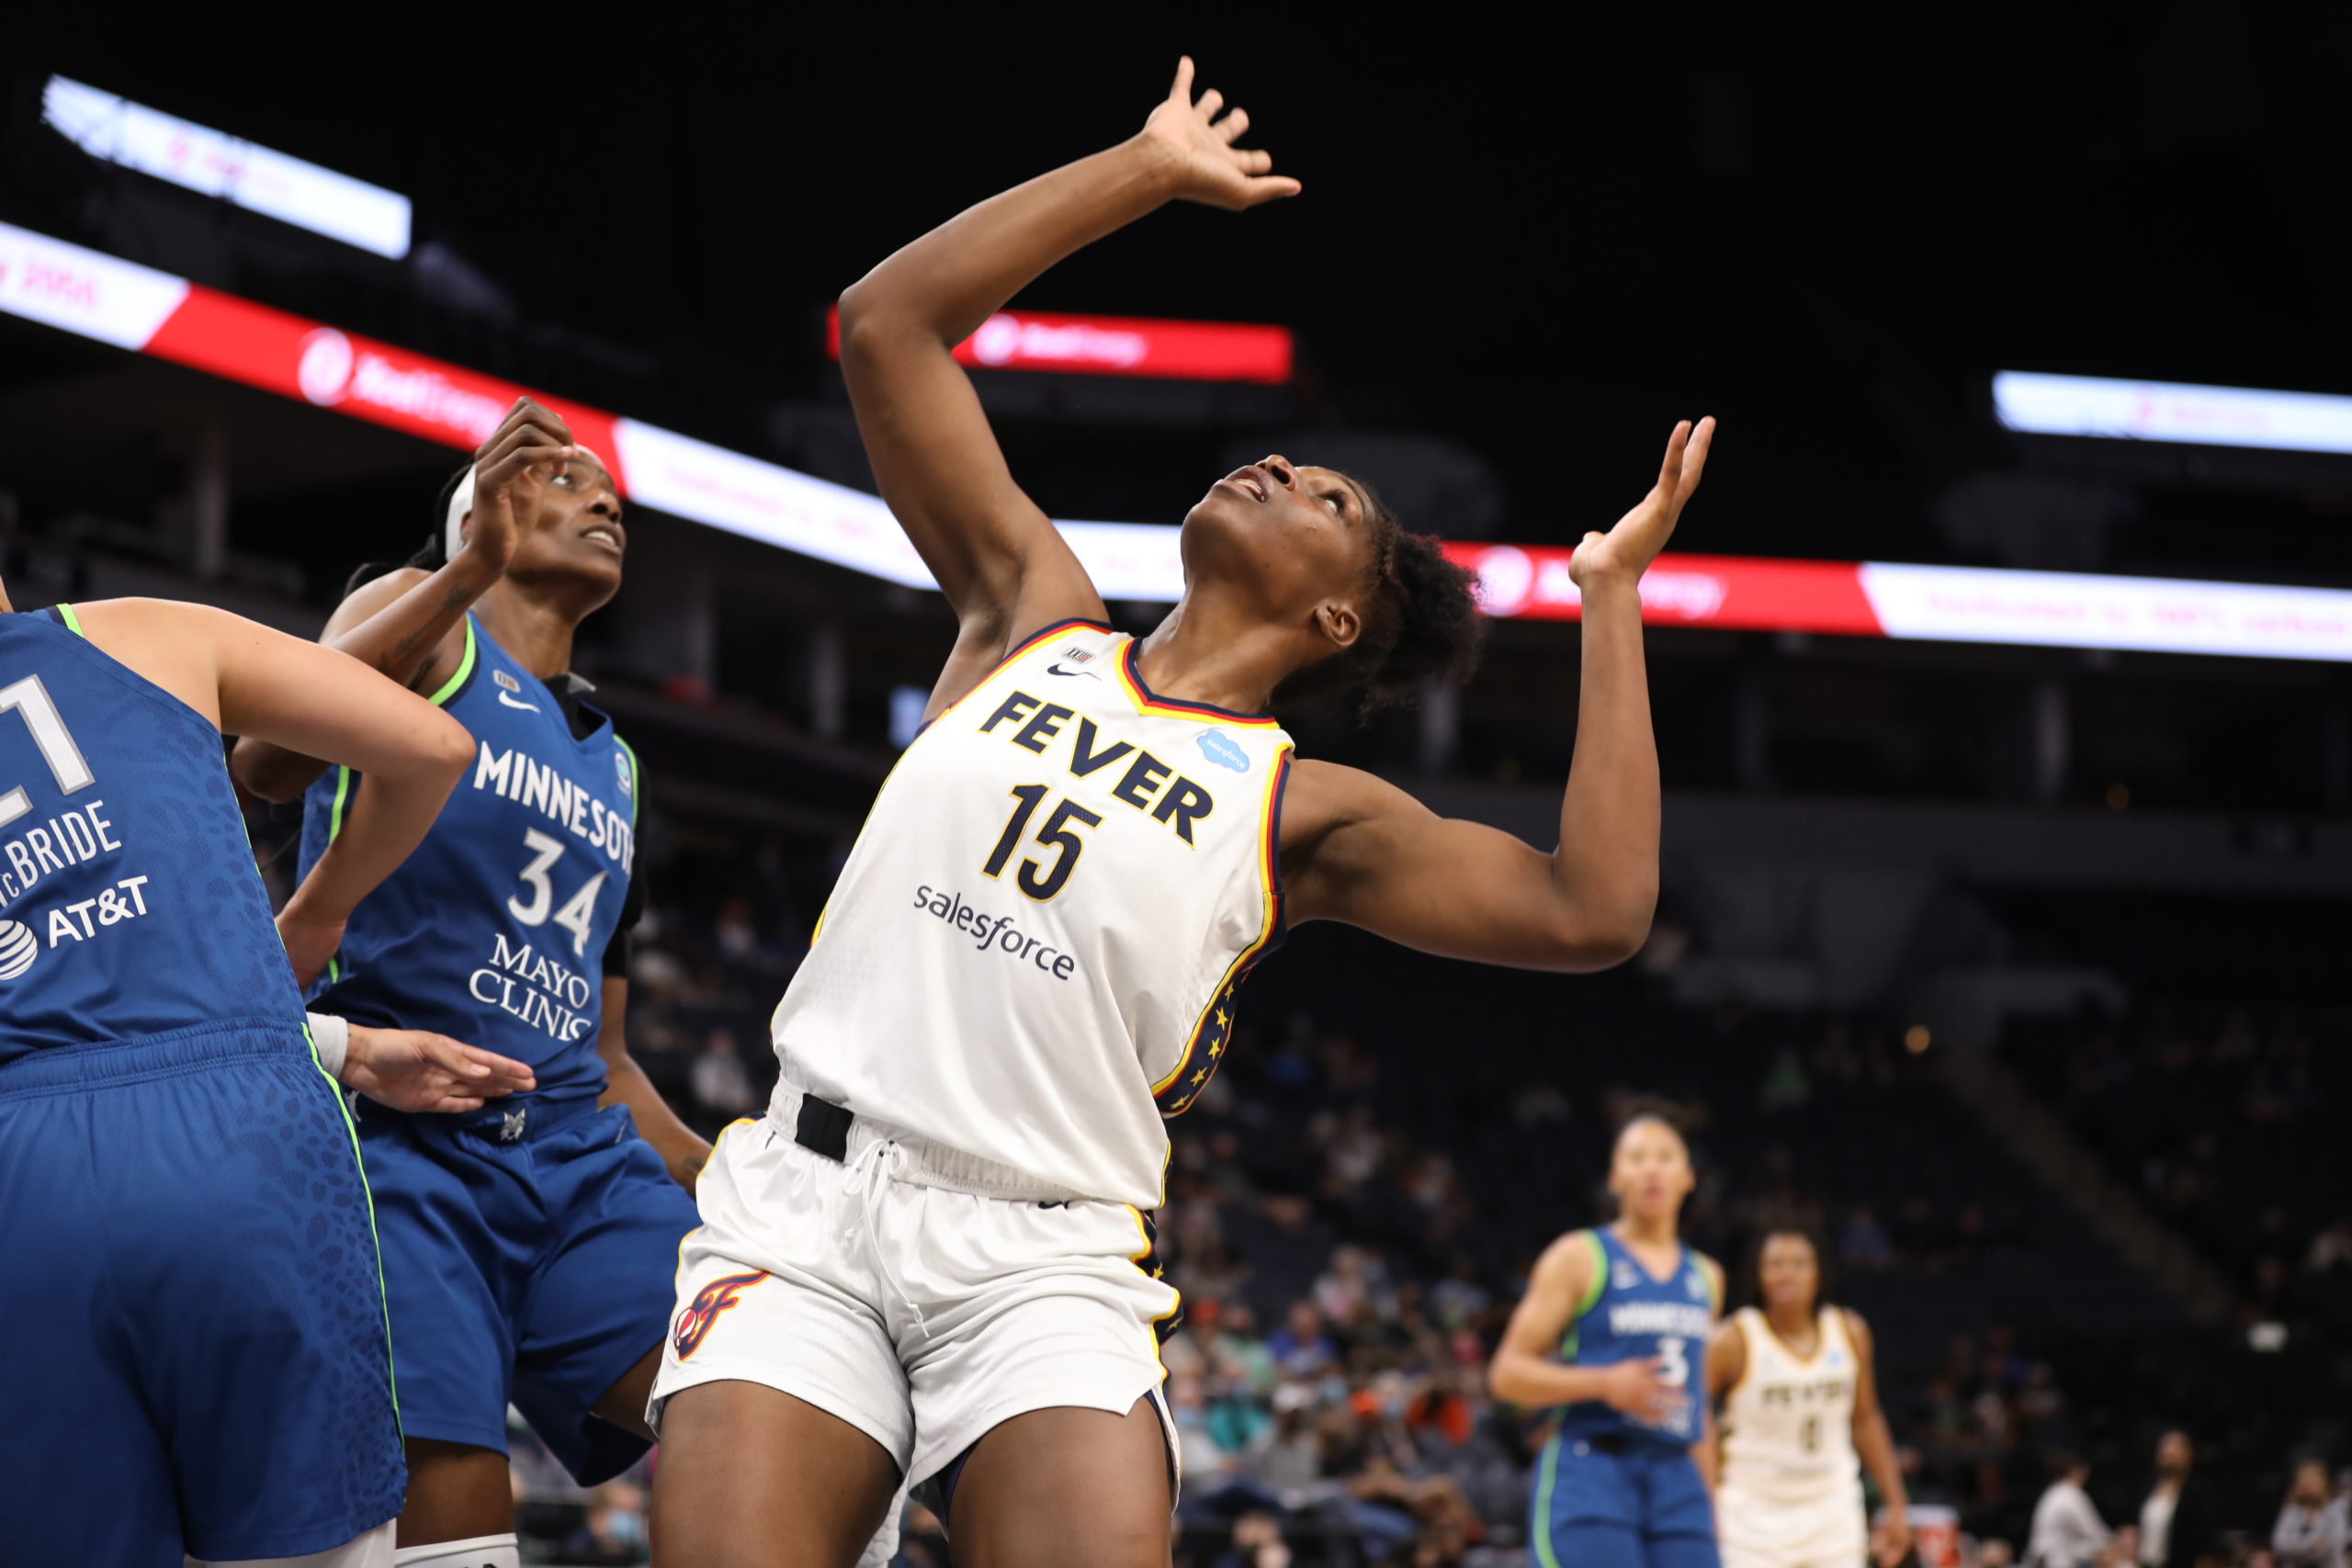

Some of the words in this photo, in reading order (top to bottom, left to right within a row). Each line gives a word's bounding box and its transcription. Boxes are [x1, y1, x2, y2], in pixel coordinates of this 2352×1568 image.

[976, 690, 1215, 852] FEVER
[1206, 739, 1246, 769] salesforce
[979, 784, 1106, 903] 15
[49, 874, 148, 949] AT&T
[507, 827, 607, 957] 34
[913, 885, 1075, 981] salesforce
[489, 933, 590, 1009] MAYO
